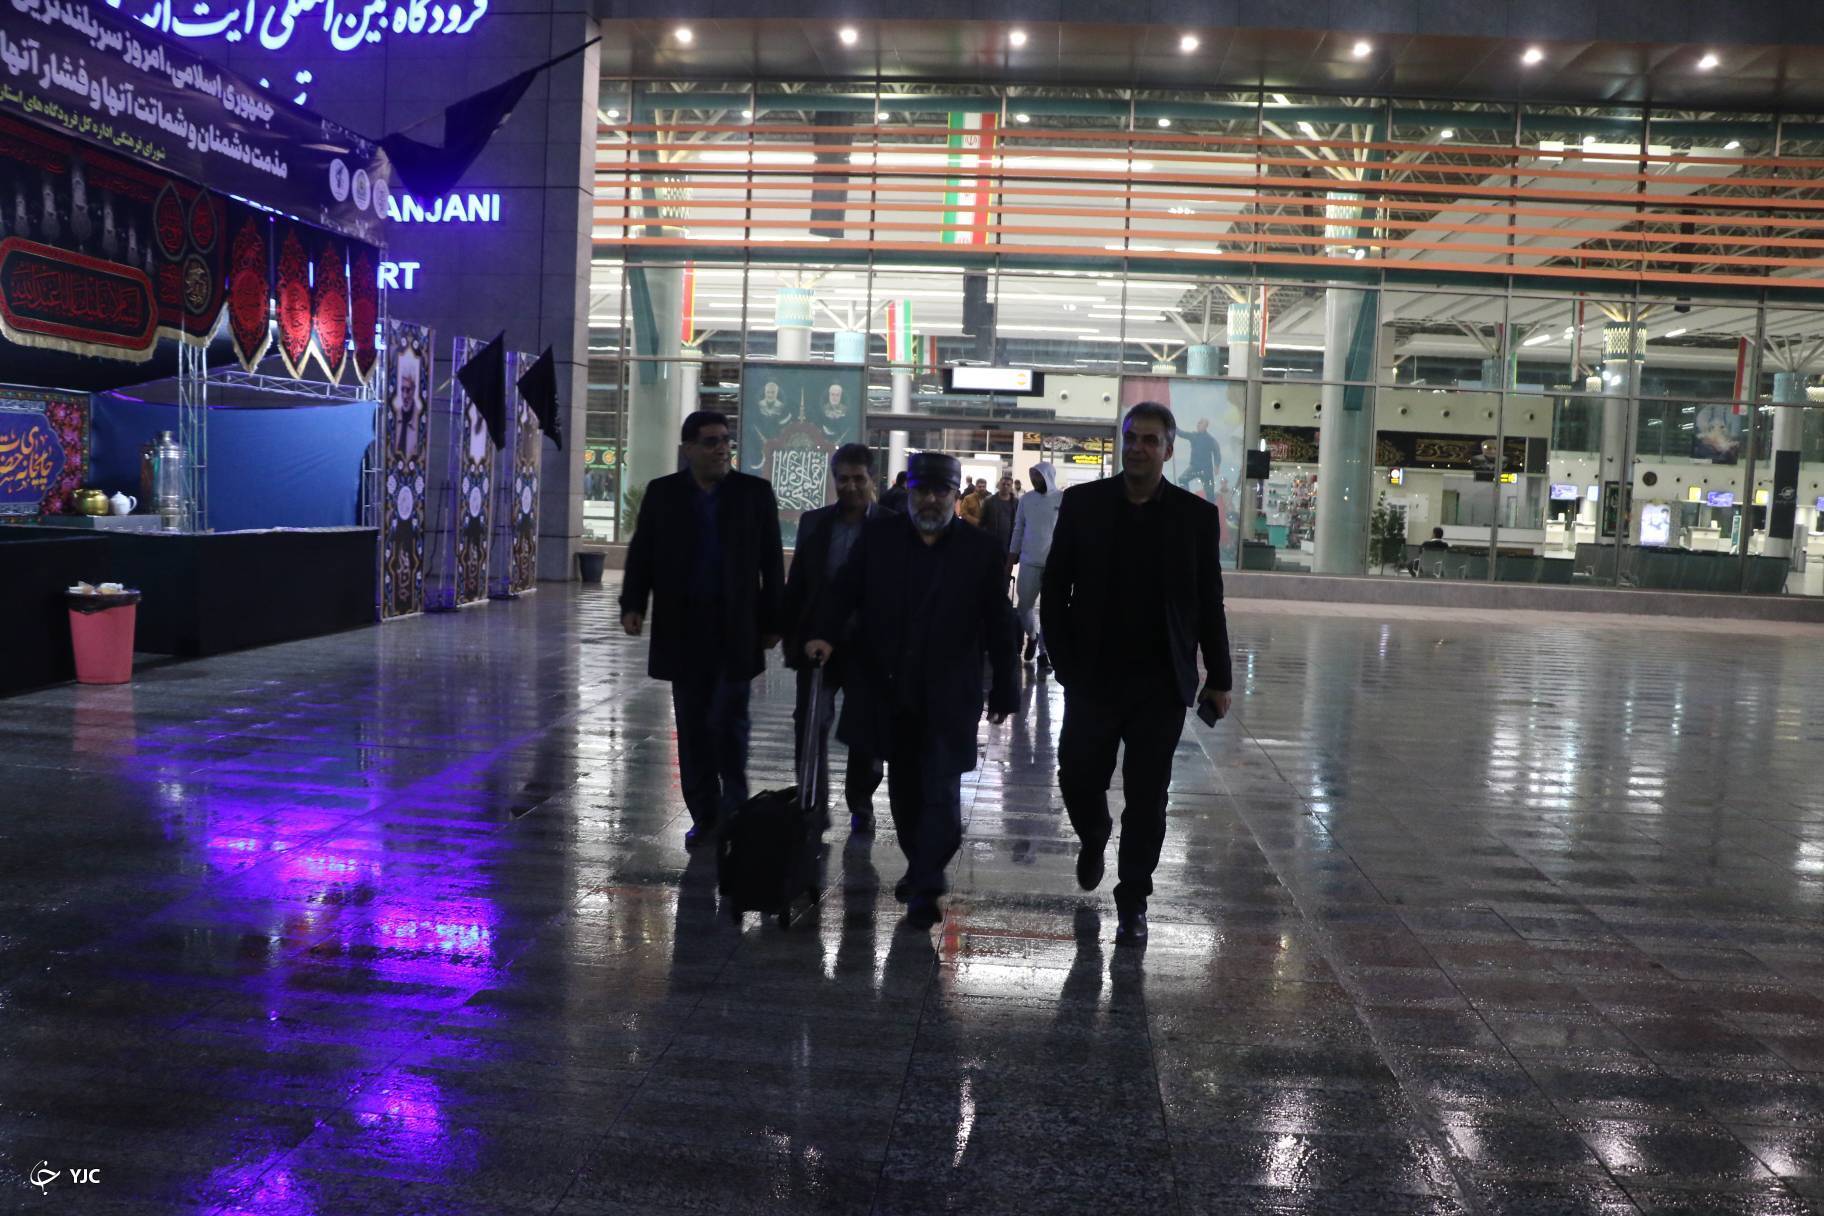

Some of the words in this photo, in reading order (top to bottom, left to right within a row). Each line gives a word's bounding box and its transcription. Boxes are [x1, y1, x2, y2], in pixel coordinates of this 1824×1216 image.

[0, 29, 41, 76] آنها
[123, 31, 165, 72] امروز
[38, 52, 90, 97] فشار
[101, 76, 135, 117] آنها
[222, 84, 275, 130] جمهوری
[134, 97, 188, 138] شماتت
[142, 142, 166, 162] شورای
[197, 124, 251, 164] دشمنان
[251, 147, 288, 179] مذمت
